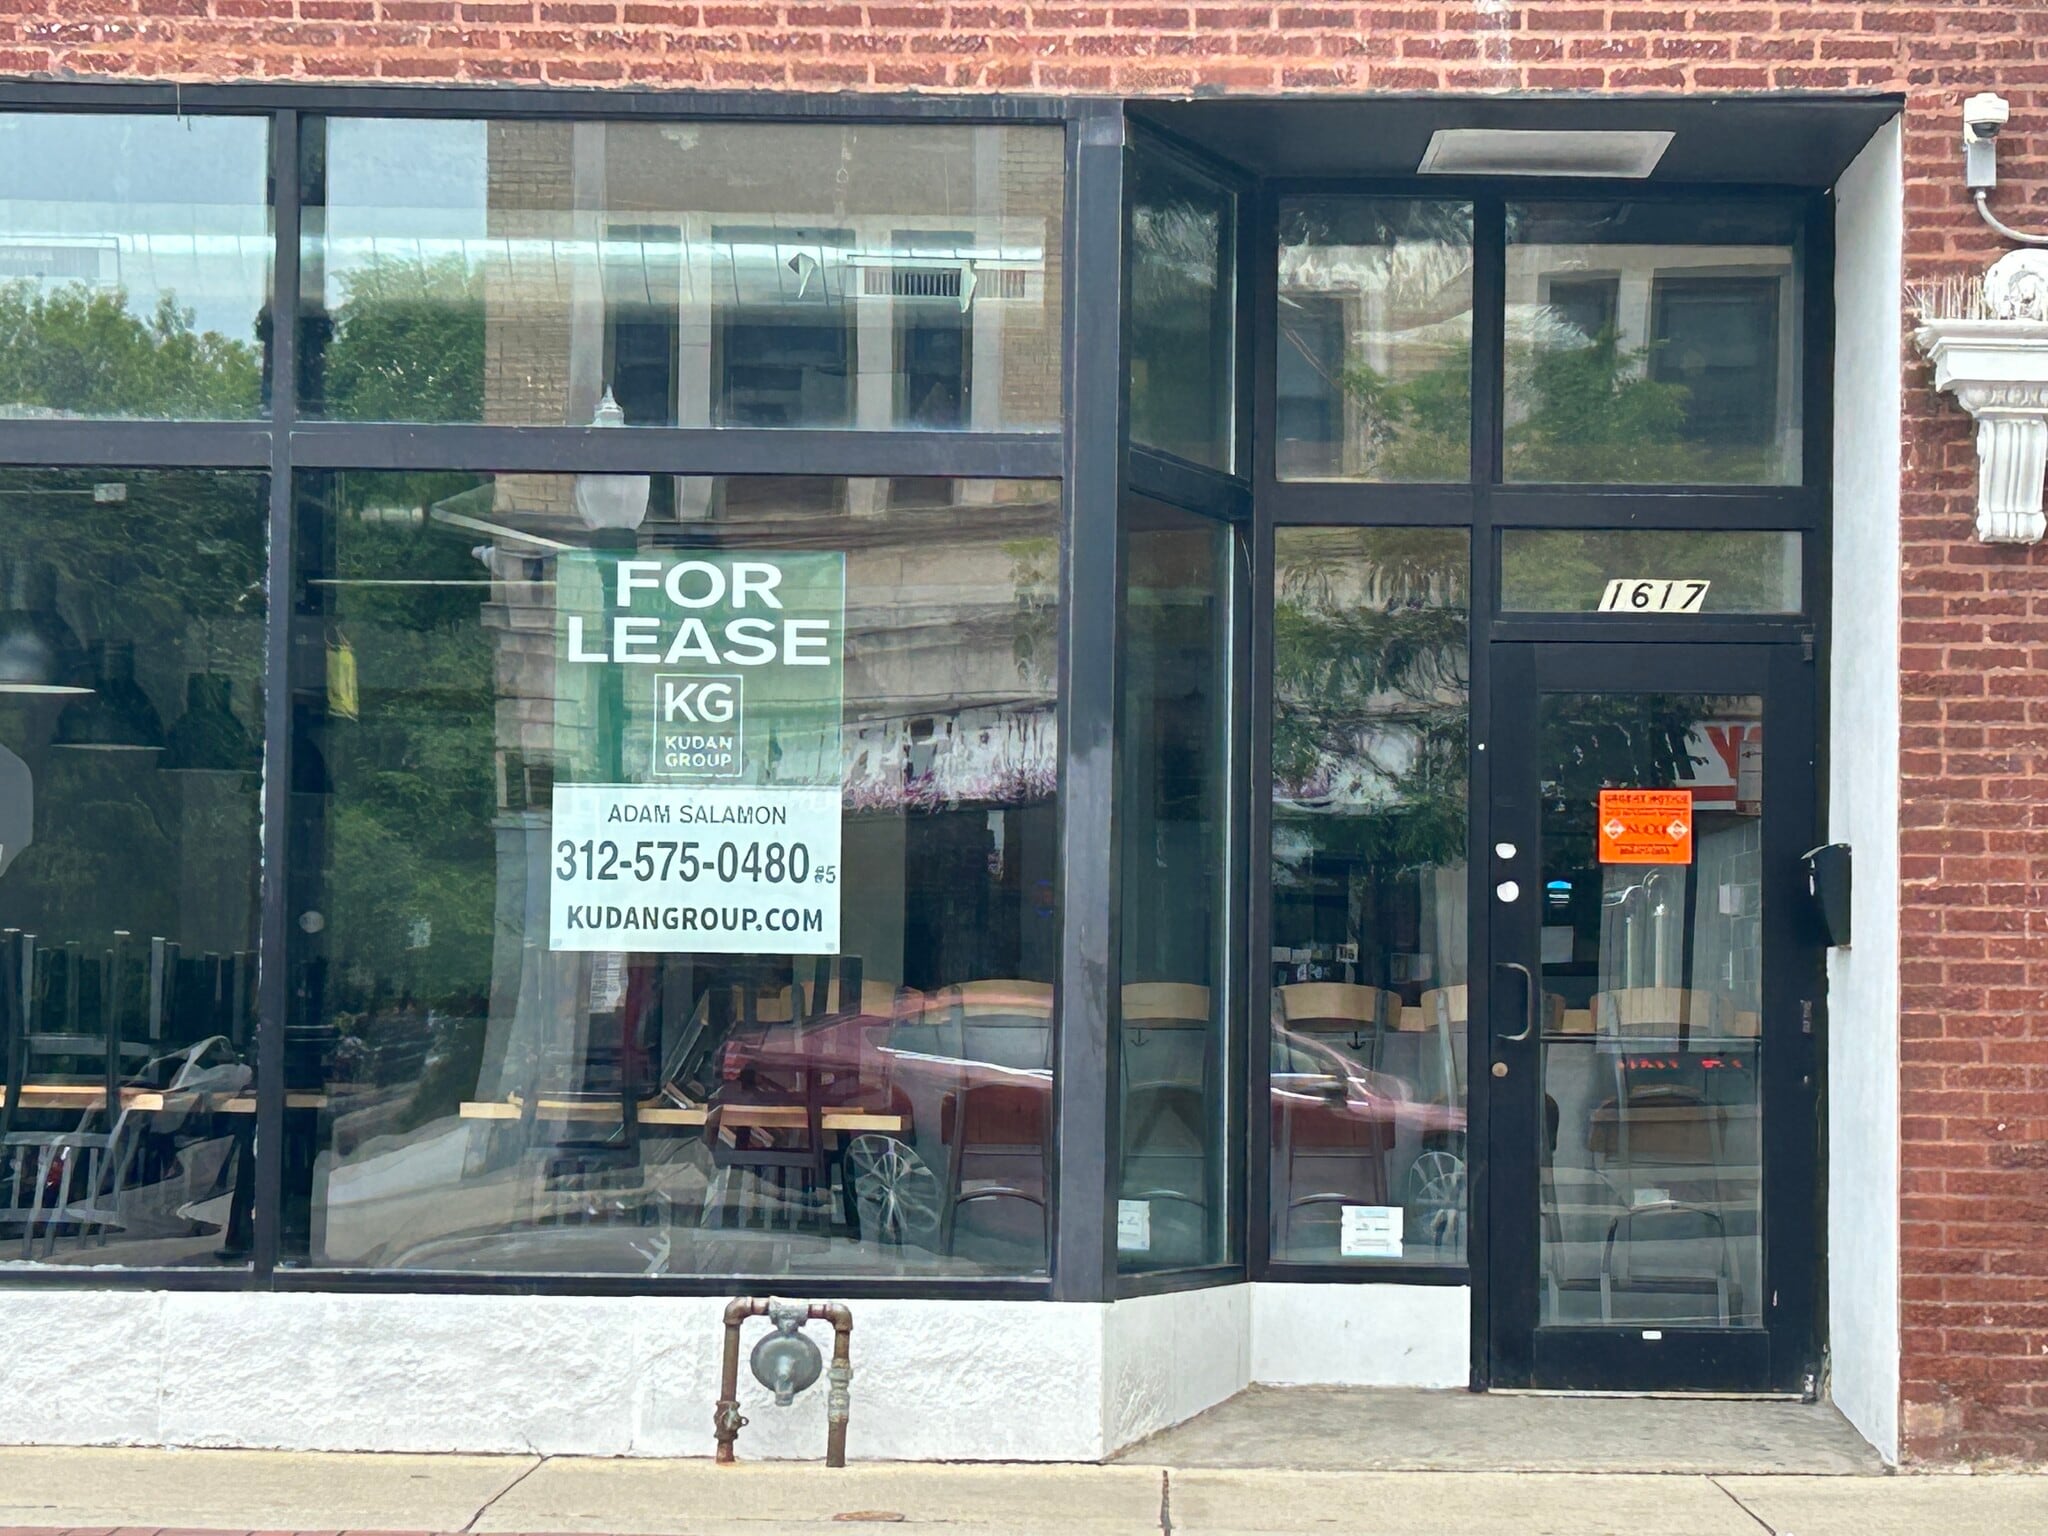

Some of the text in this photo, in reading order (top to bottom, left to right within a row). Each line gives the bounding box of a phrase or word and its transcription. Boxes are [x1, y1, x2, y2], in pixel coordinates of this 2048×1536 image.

[617, 560, 784, 609] FOR
[1609, 582, 1706, 610] 1617
[568, 616, 831, 666] LEASE
[665, 682, 734, 723] KG
[665, 735, 733, 750] KUDAN
[665, 753, 732, 767] GROUP
[607, 804, 786, 824] ADAM SALAMON
[556, 839, 810, 884] 312-575-0480
[567, 905, 823, 932] KUDANGROUP.COM
